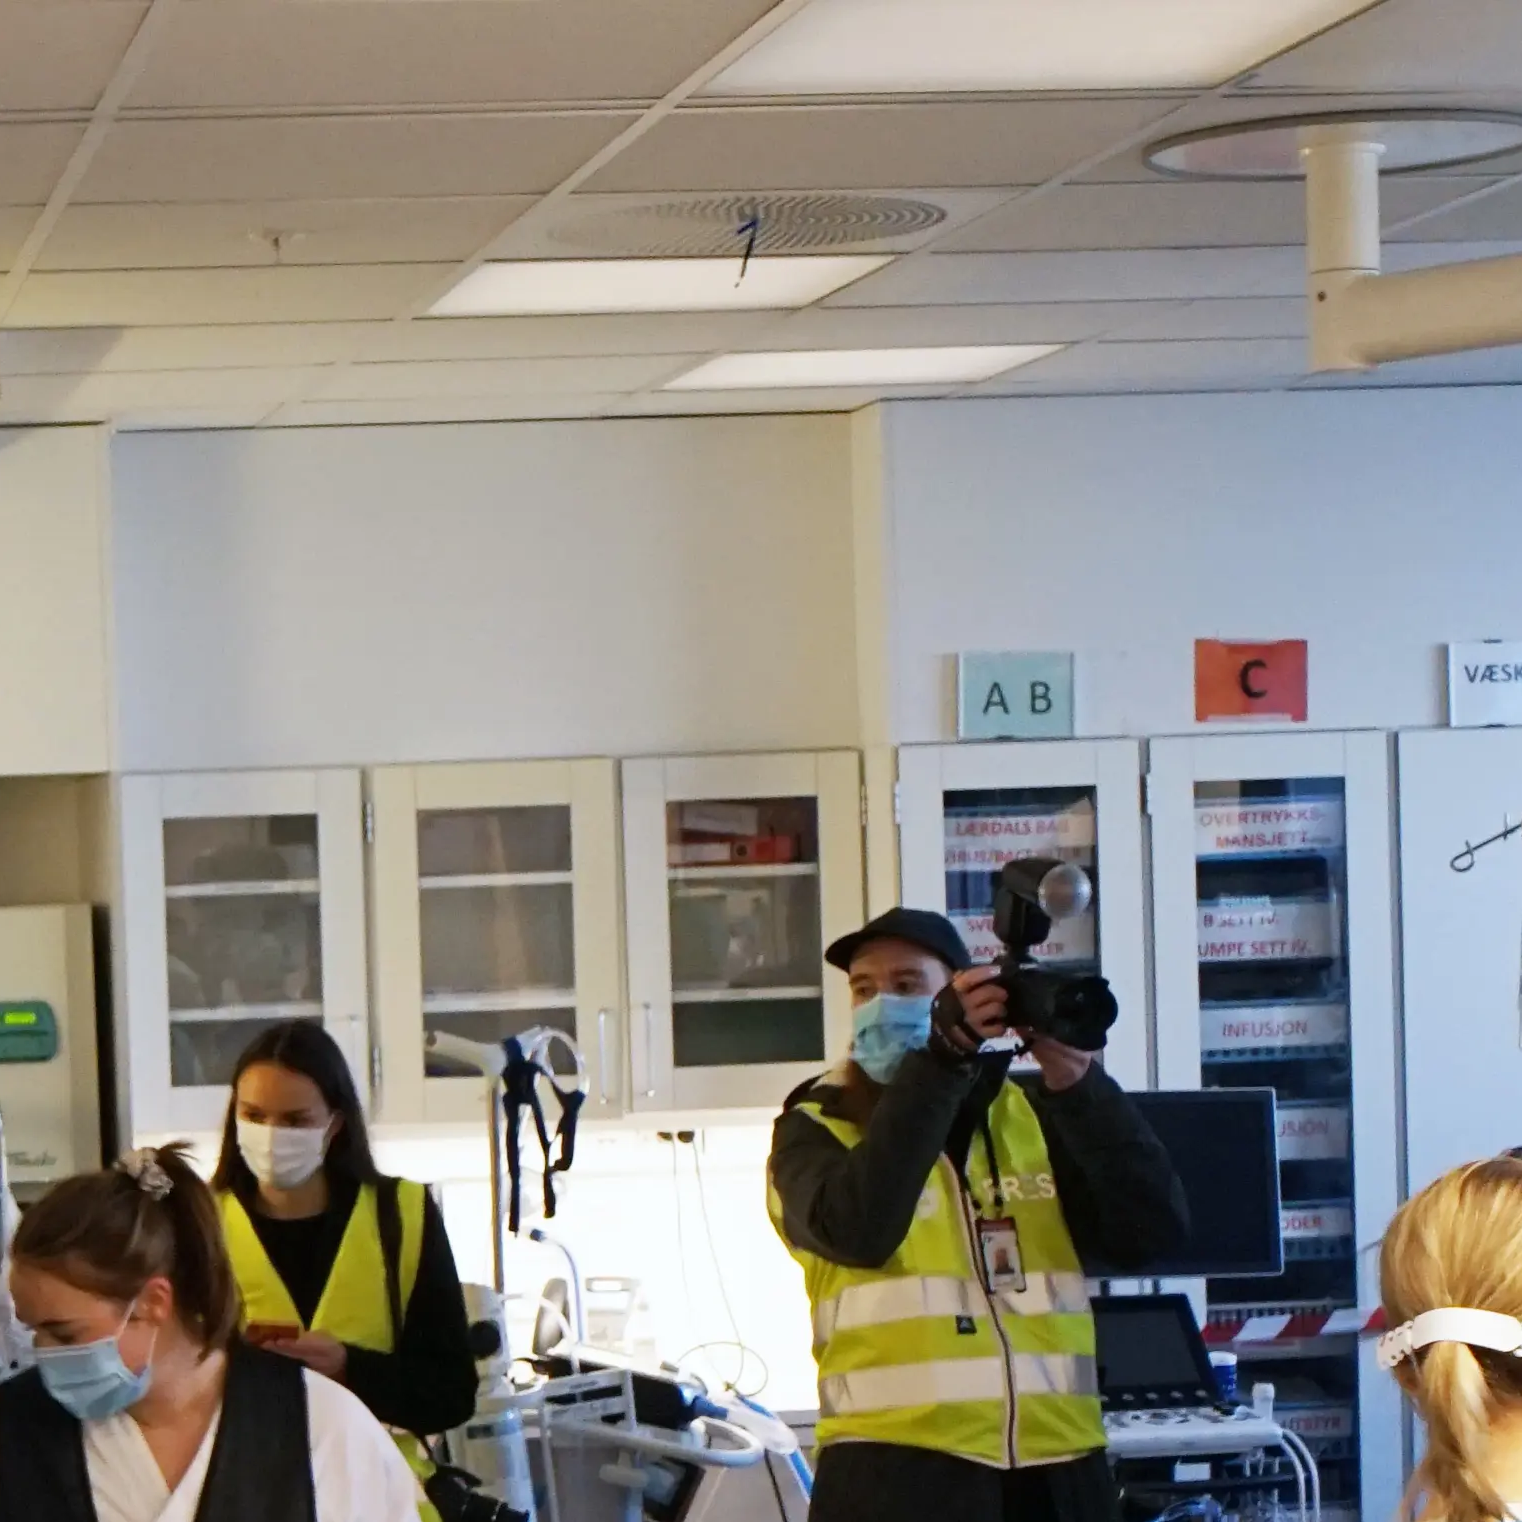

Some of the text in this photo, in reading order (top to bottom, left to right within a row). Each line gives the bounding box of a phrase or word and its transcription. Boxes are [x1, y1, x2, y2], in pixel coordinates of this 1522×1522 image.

[1238, 660, 1268, 698] C
[983, 682, 1052, 714] A B
